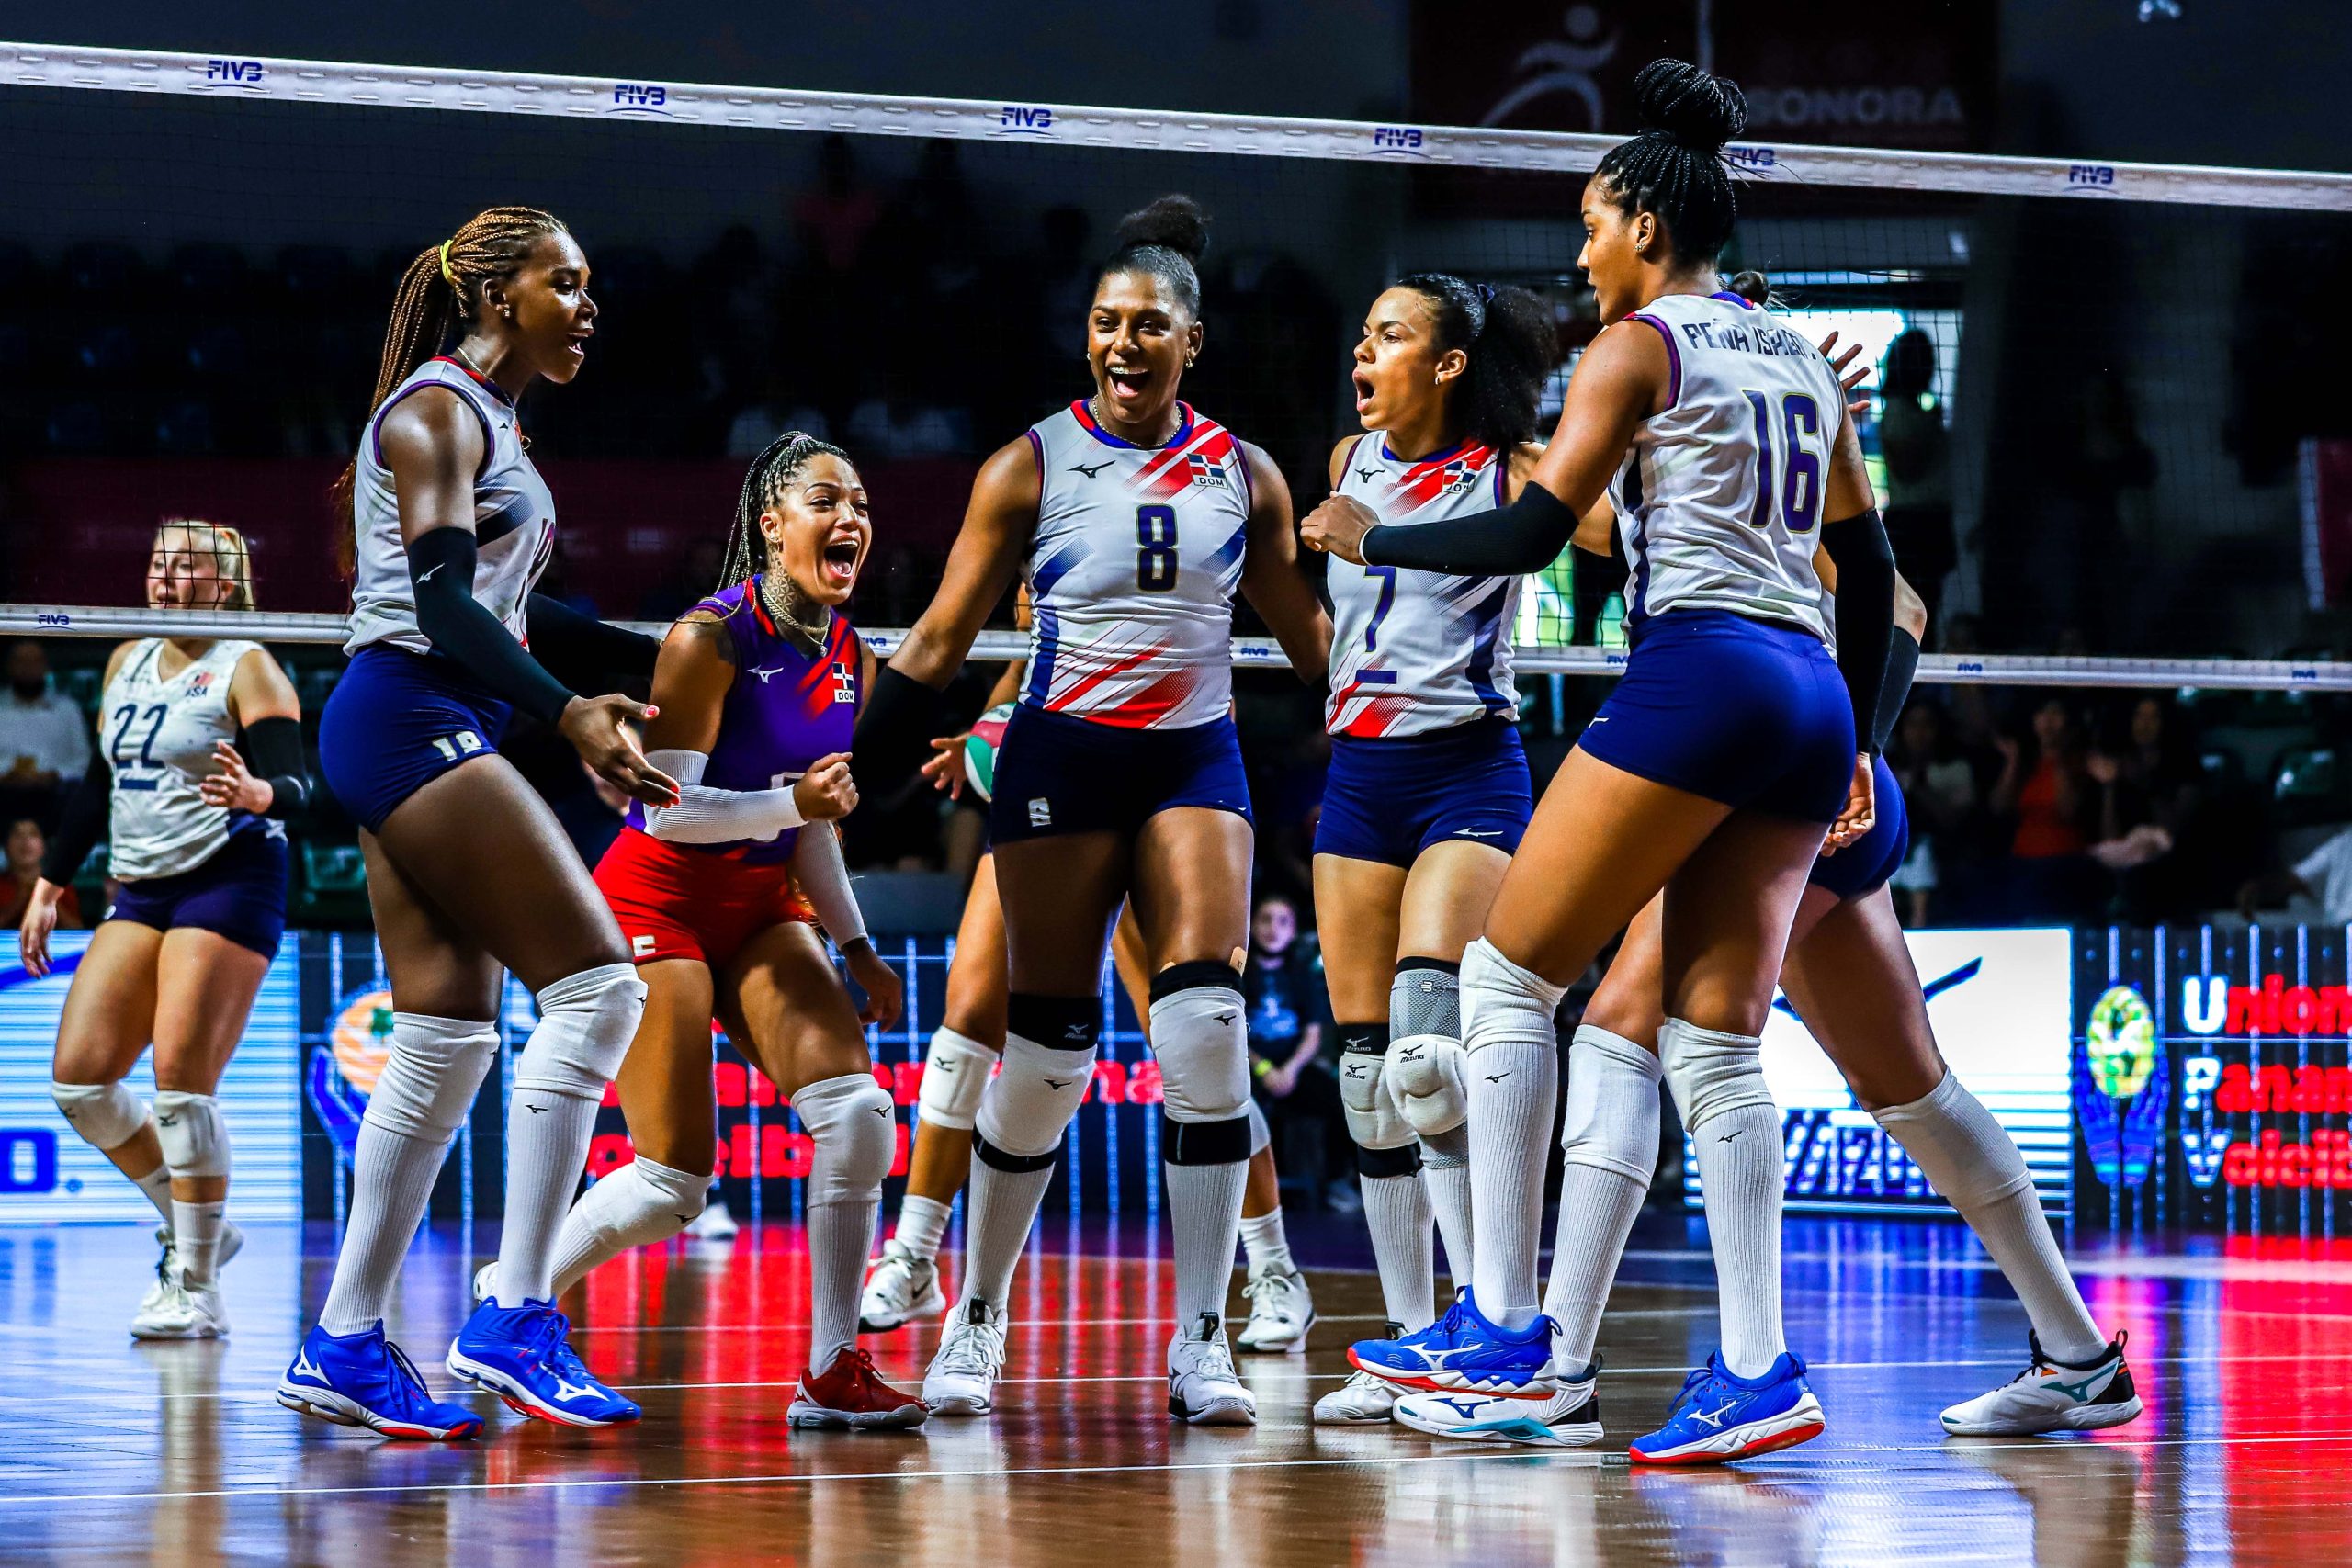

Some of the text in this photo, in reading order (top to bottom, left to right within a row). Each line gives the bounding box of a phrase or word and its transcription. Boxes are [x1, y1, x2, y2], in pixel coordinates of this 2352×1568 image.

[207, 60, 263, 82] FIVB
[615, 85, 665, 106] FIVB
[1745, 87, 1964, 125] SONORA
[1001, 107, 1052, 128] FIVB
[1374, 128, 1422, 148] FIVB
[1742, 388, 1820, 535] 16
[1199, 477, 1224, 487] DOM
[1136, 503, 1179, 592] 8
[38, 614, 70, 626] FIVB
[1363, 564, 1397, 654] 7
[112, 704, 168, 769] 22
